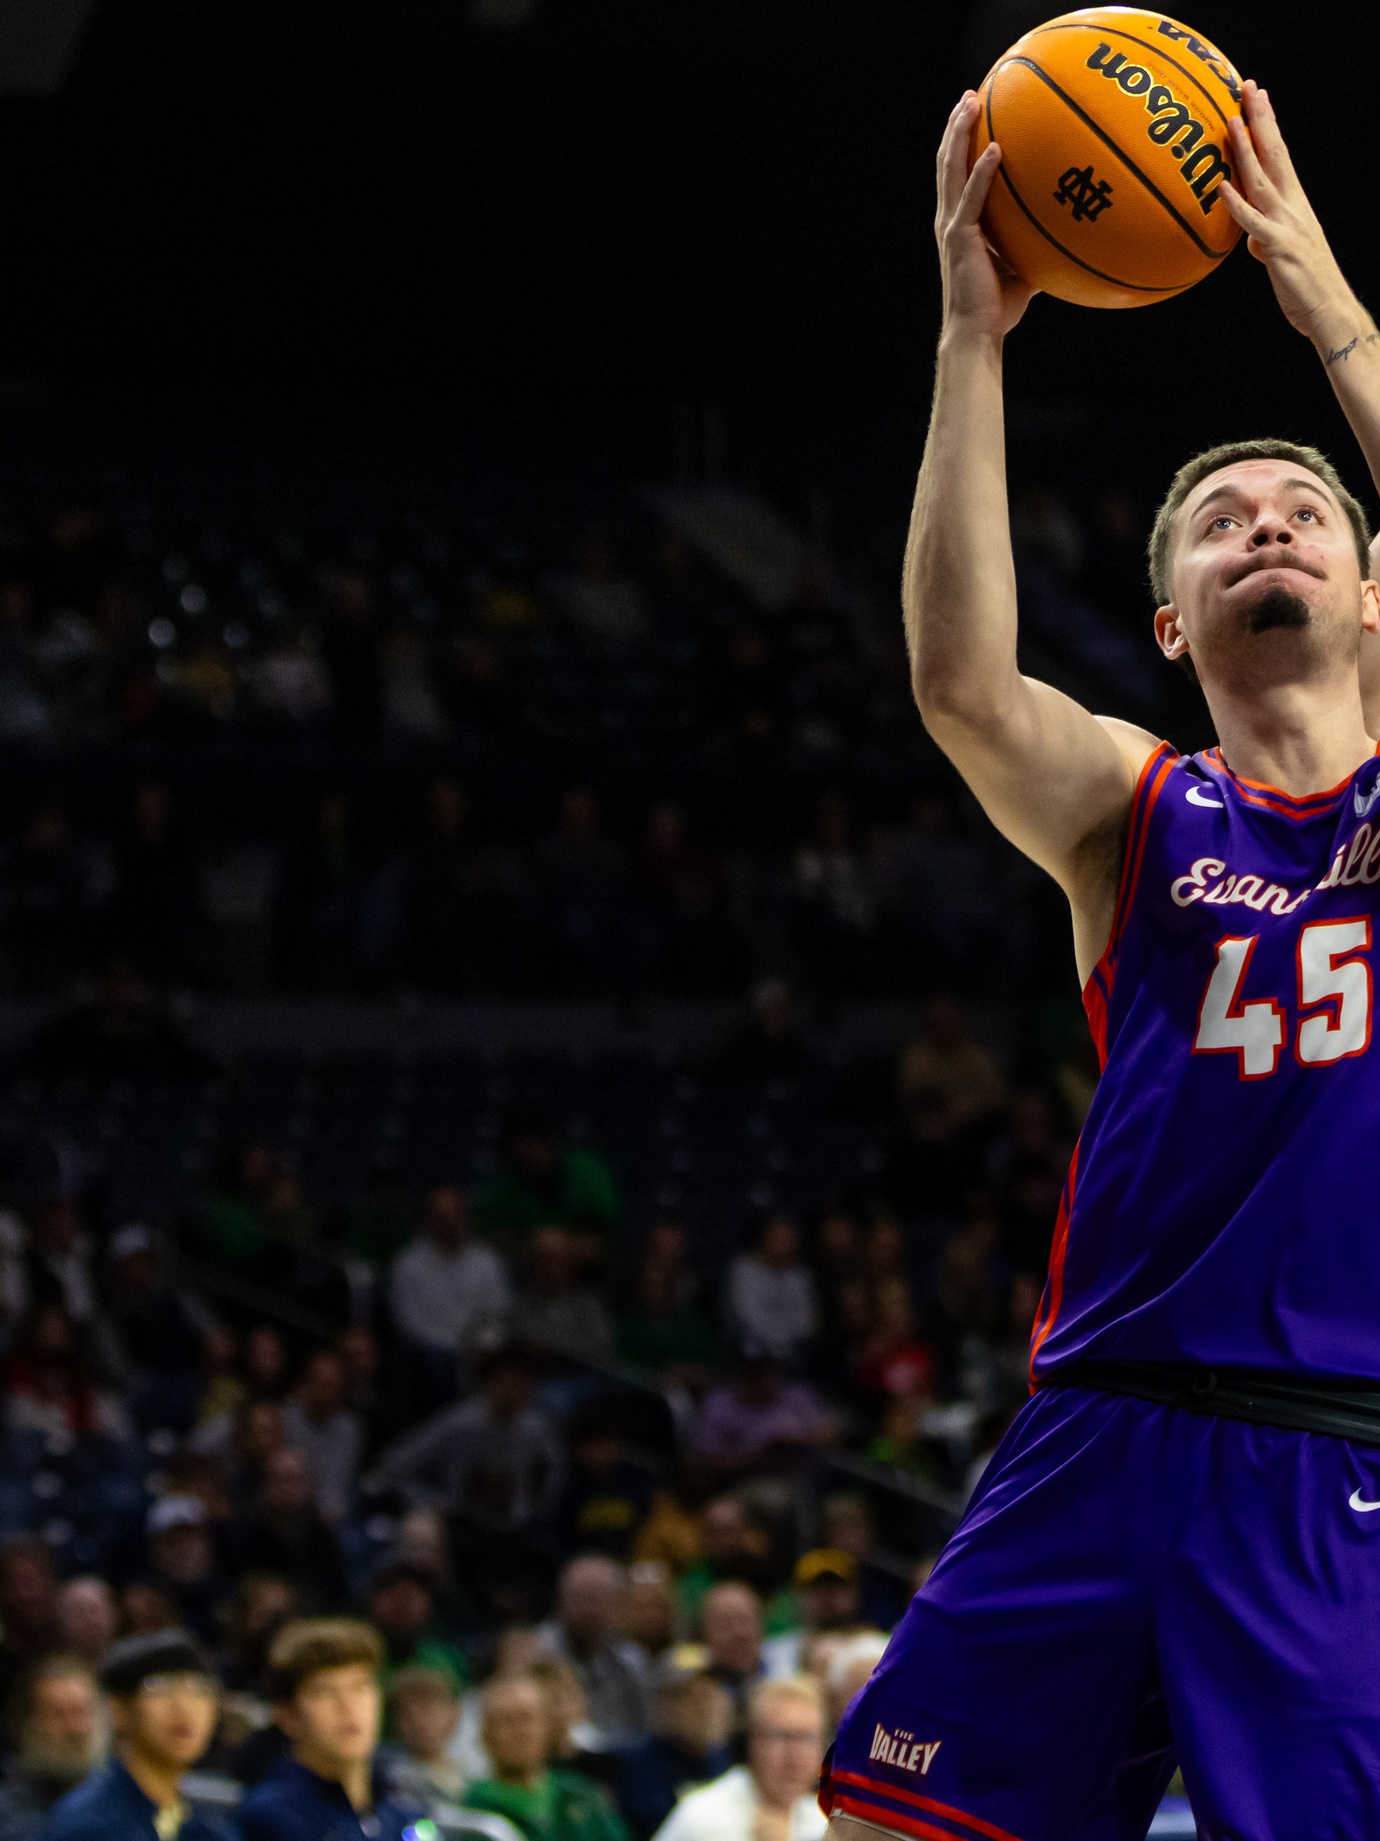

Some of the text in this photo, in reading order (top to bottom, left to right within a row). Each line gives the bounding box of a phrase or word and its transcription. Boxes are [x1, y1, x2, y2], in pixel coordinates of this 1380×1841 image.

[1085, 42, 1232, 216] Wilson
[1191, 914, 1374, 1081] 45
[868, 1722, 943, 1776] VALLEY
[893, 1728, 915, 1742] THE
